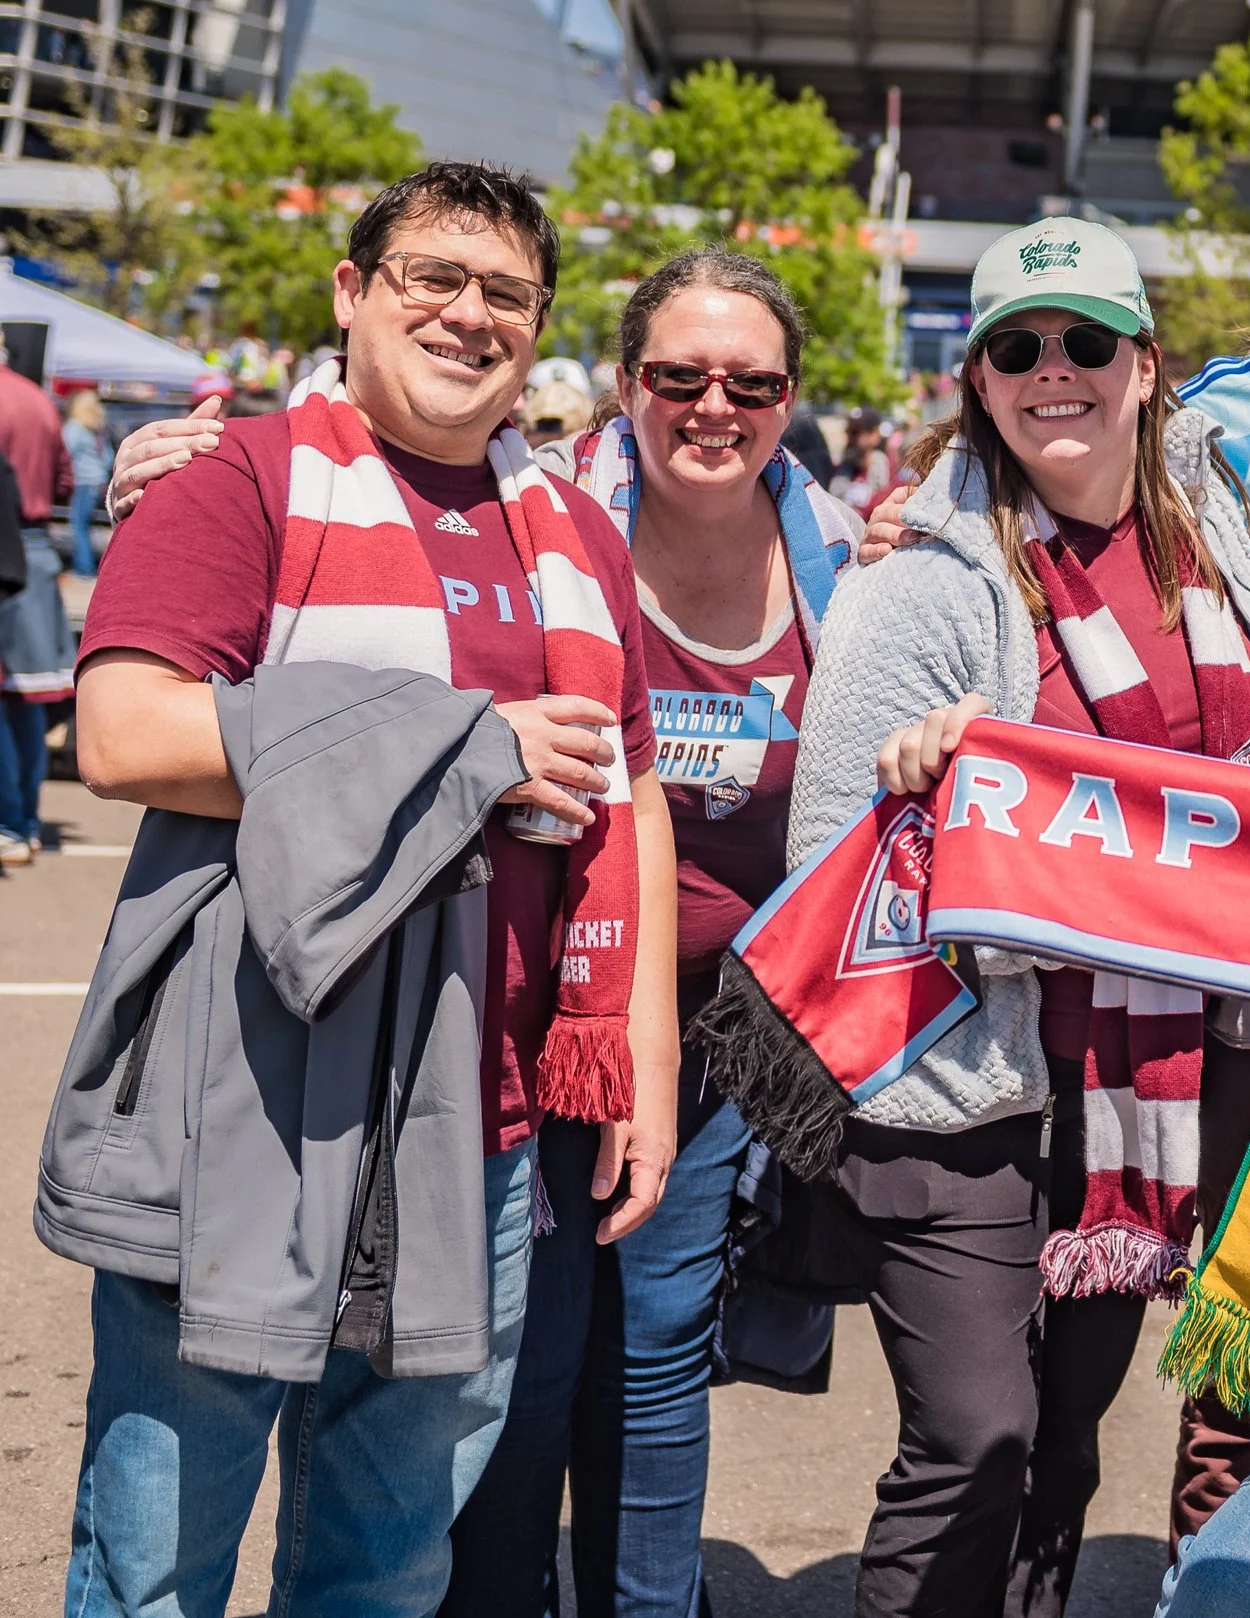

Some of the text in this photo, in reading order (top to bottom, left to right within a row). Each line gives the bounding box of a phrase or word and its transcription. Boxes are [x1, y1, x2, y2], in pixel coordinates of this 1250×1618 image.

[1019, 239, 1081, 259] Colorado
[1022, 253, 1078, 274] Rapids
[434, 521, 479, 537] adidas
[650, 695, 743, 733] OLORADO
[655, 741, 724, 778] APIDS
[879, 922, 892, 937] 96
